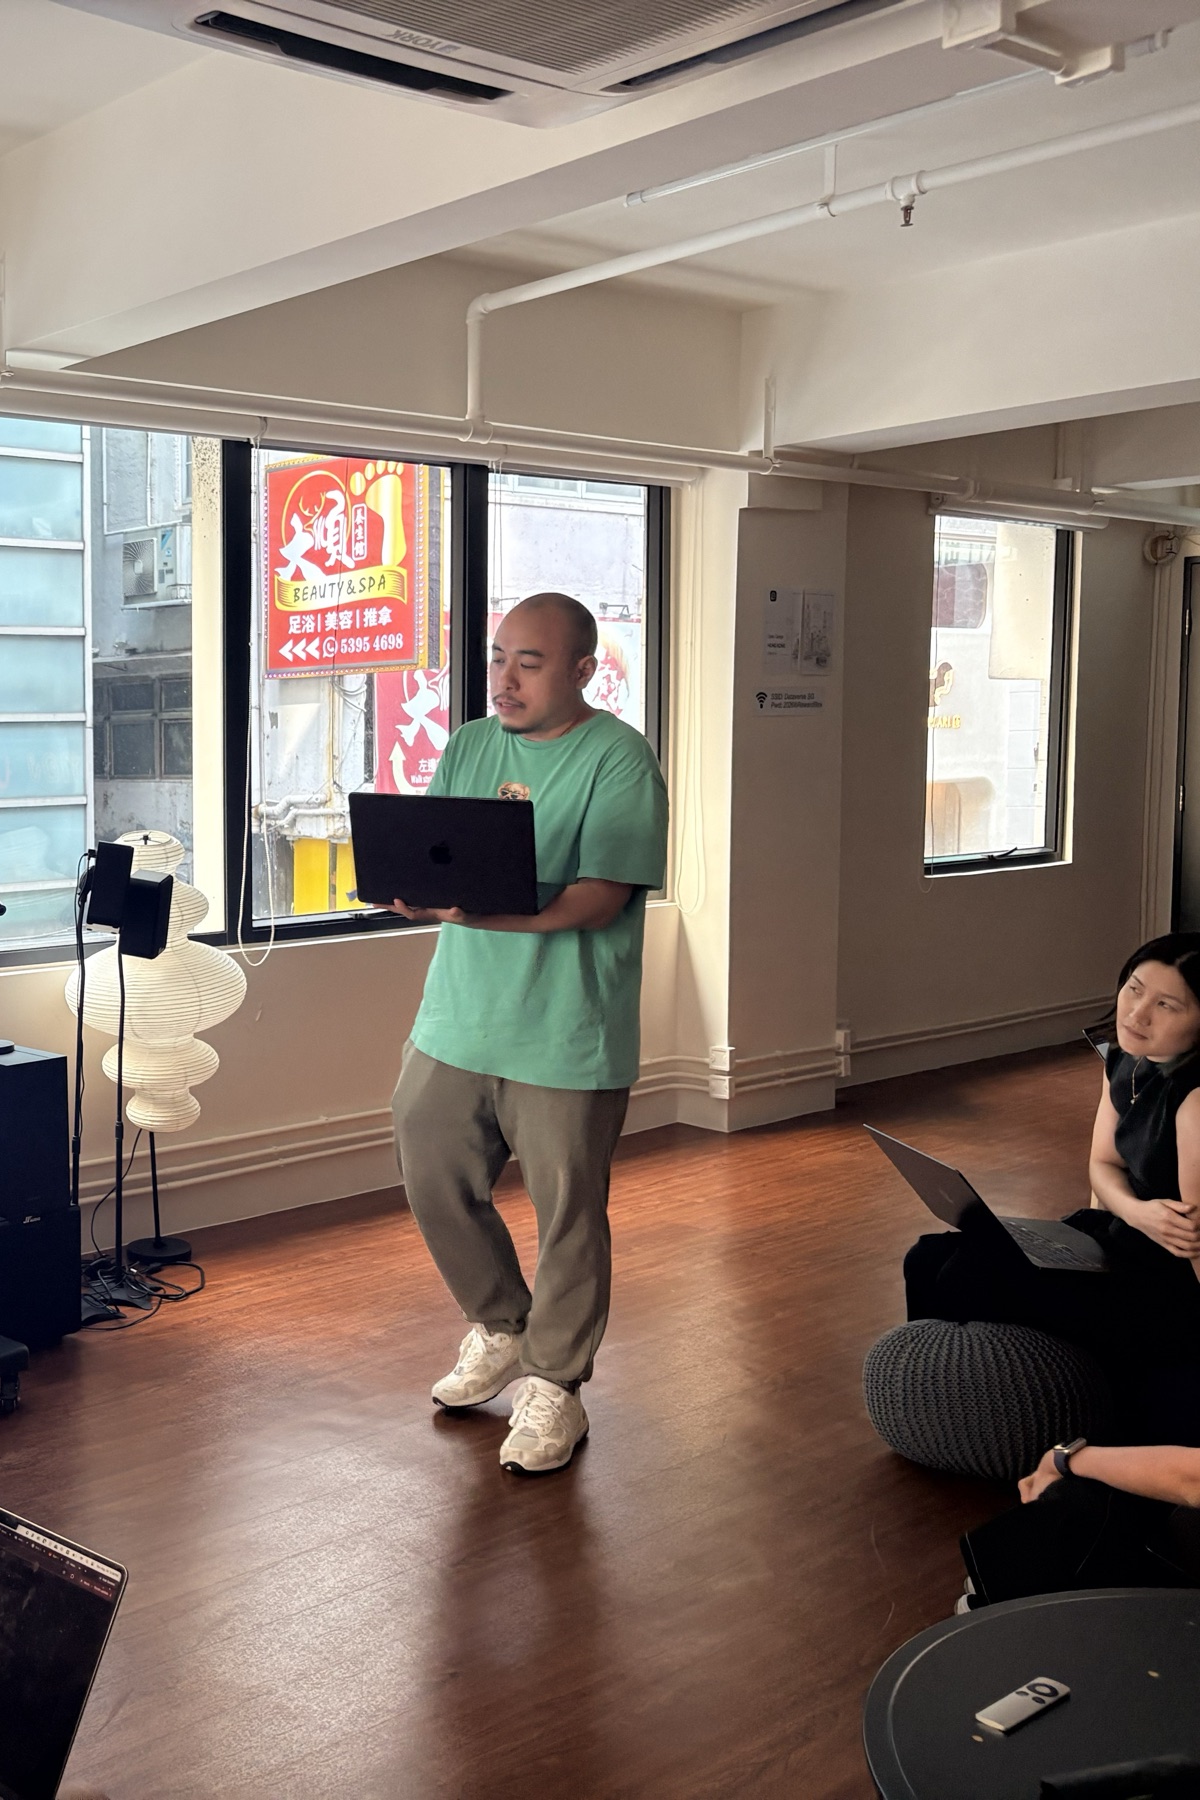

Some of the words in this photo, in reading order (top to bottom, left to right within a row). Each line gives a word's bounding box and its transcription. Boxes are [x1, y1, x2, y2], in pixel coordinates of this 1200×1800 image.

[386, 30, 442, 49] YORK
[288, 614, 316, 634] 足浴
[325, 612, 353, 631] 美容
[363, 607, 392, 628] 推拿
[340, 637, 370, 653] 5395
[373, 634, 404, 650] 4698
[419, 758, 440, 773] 左邊
